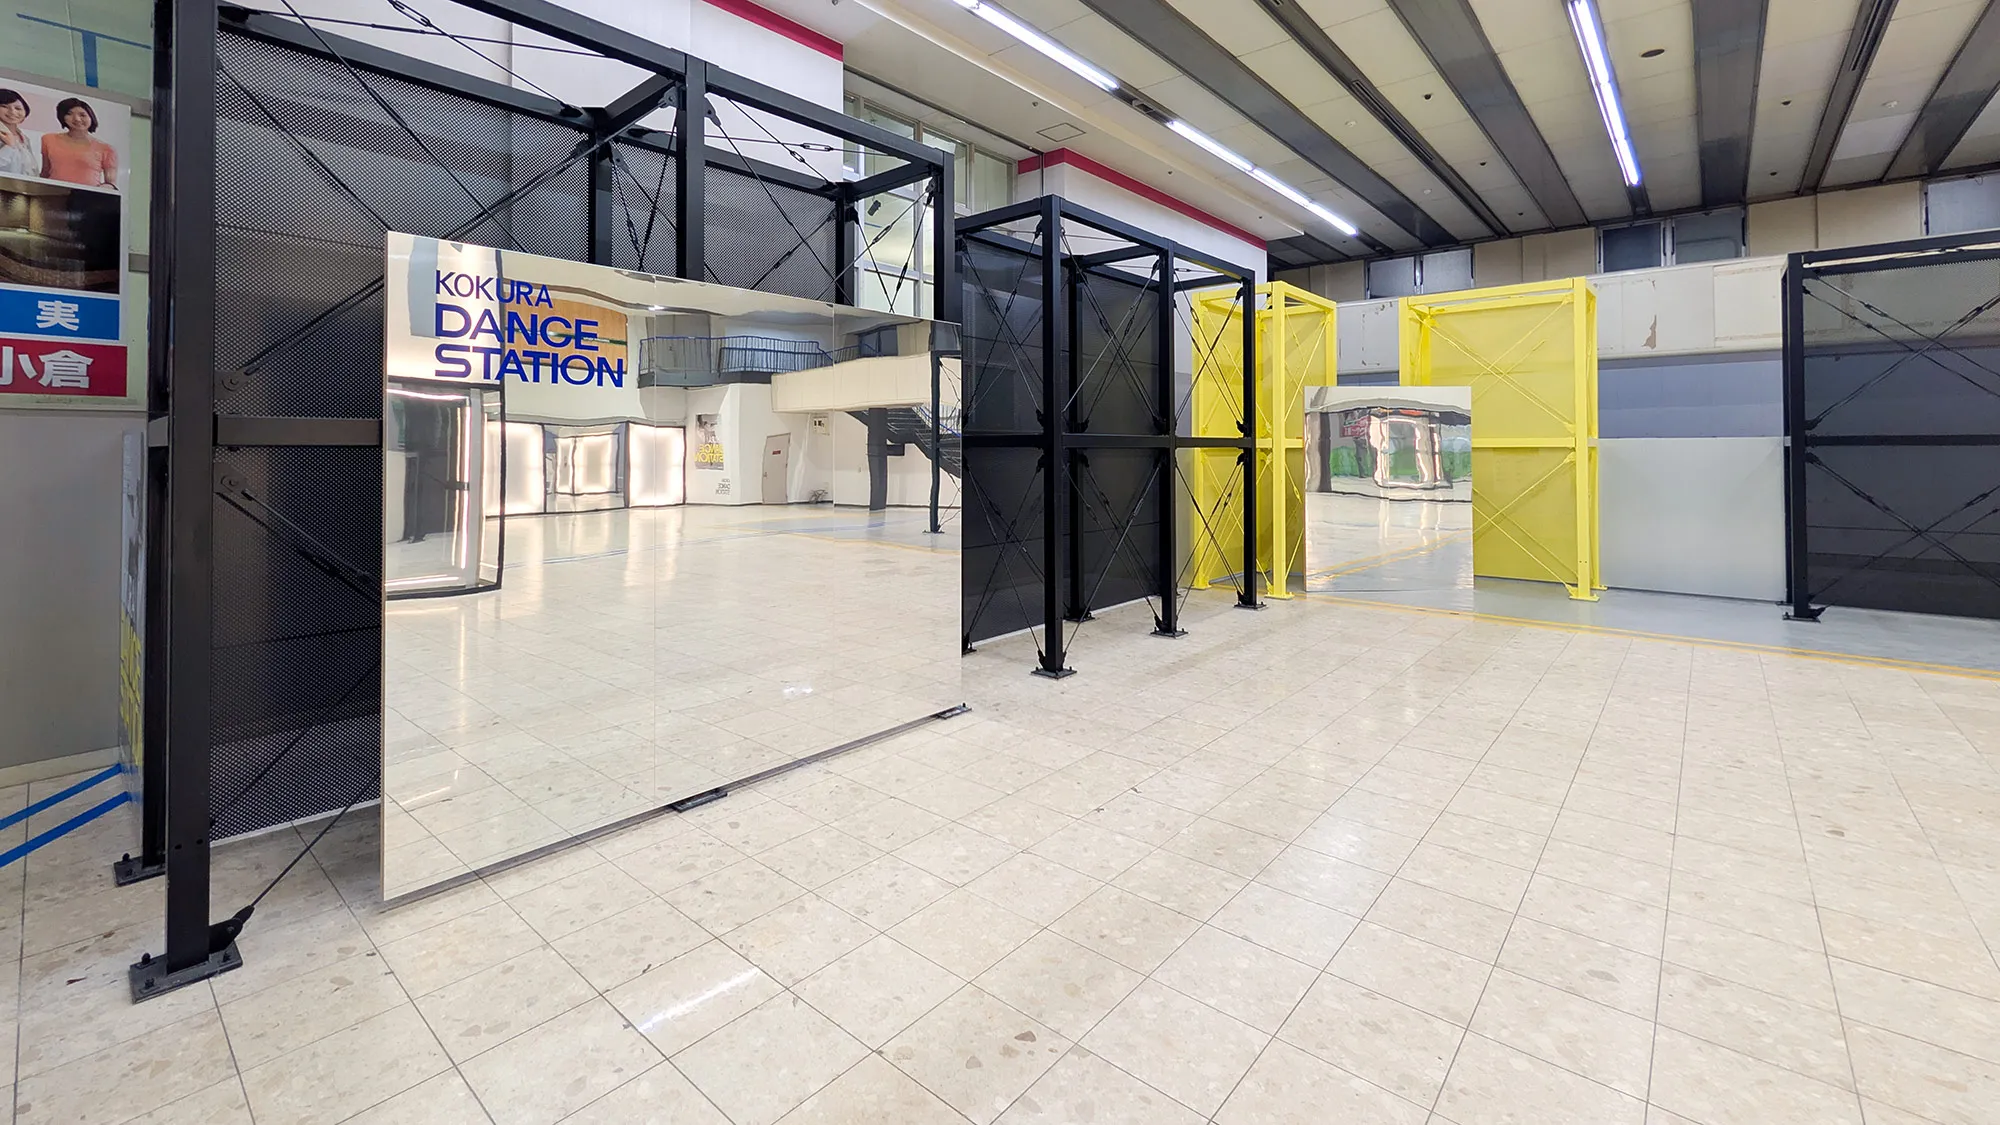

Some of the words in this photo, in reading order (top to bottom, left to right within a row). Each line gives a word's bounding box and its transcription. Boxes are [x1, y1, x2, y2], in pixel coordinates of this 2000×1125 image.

[435, 269, 554, 309] KOKURA
[36, 300, 80, 332] 実
[435, 302, 599, 352] DANCE
[435, 343, 624, 388] STATION
